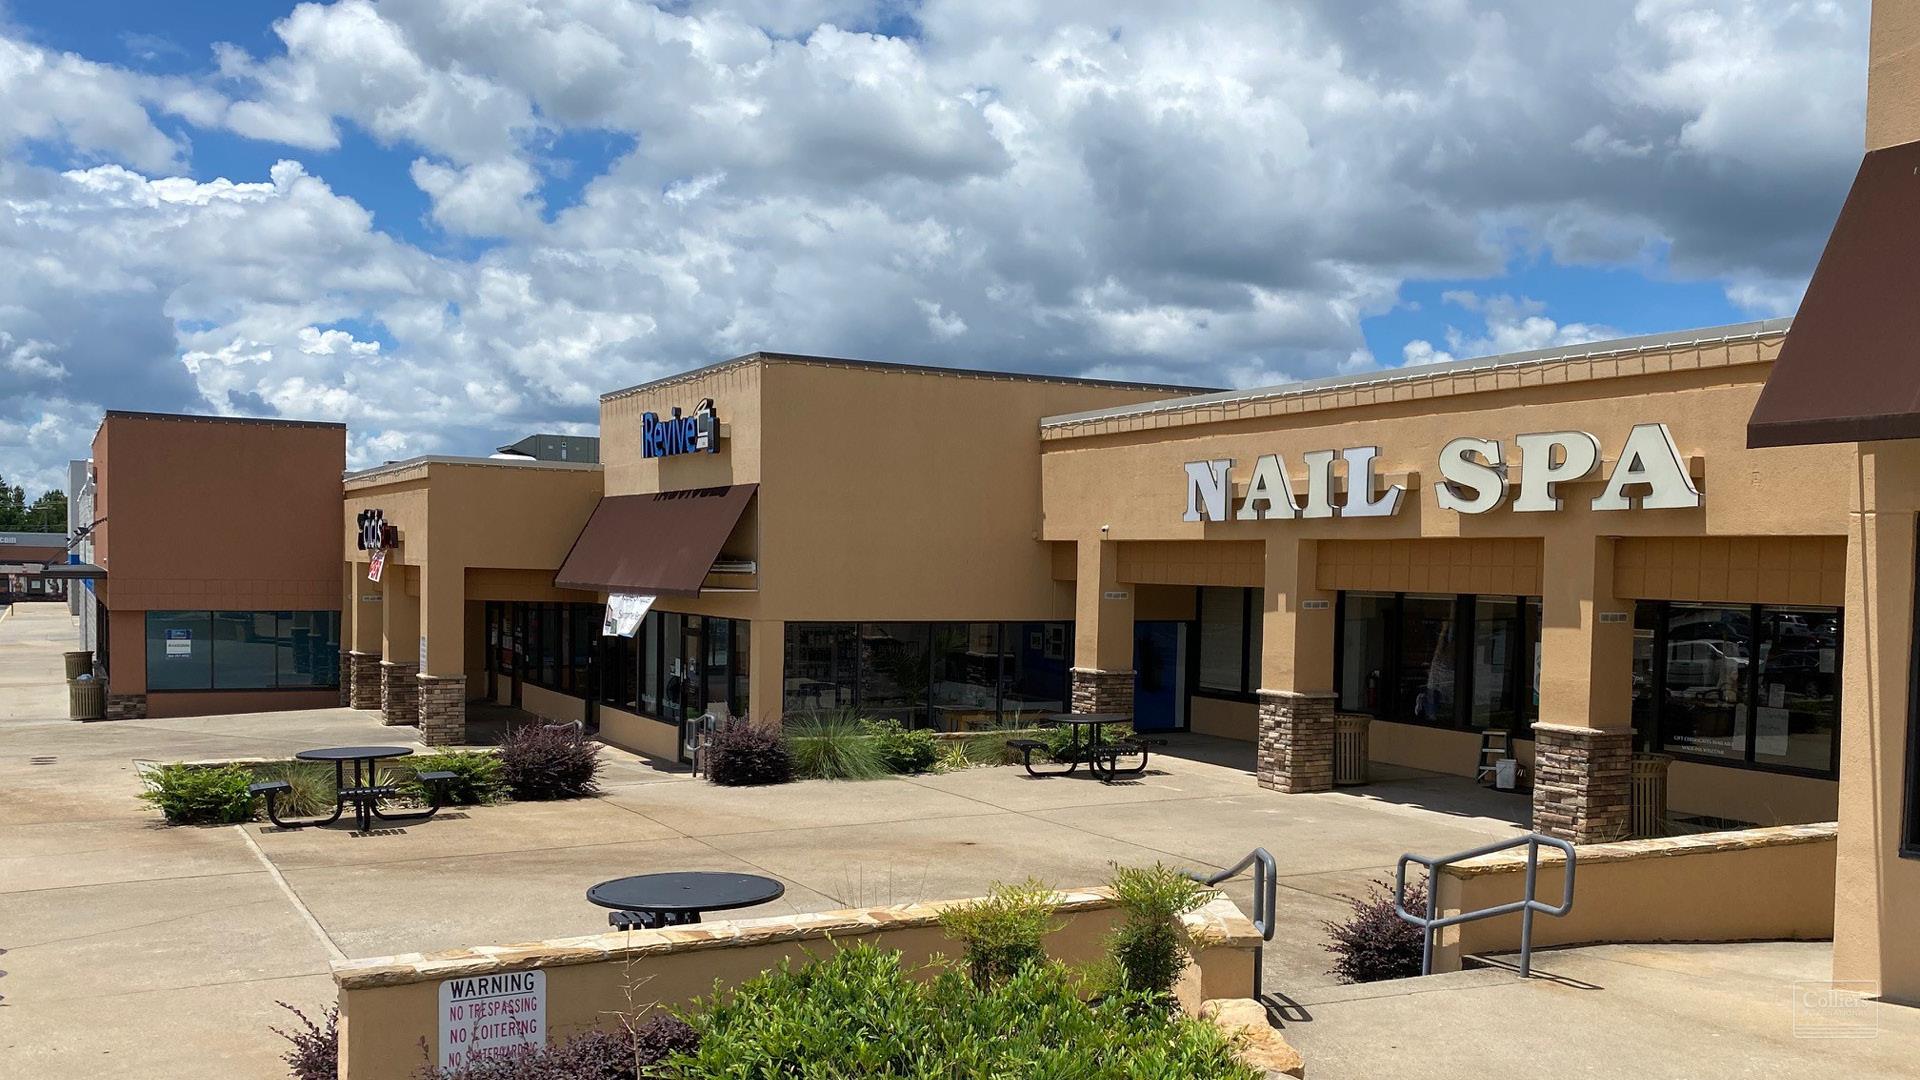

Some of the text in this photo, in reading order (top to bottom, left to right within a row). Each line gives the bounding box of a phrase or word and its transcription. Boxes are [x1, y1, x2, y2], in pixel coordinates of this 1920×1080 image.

[640, 407, 696, 458] iRevive
[1183, 423, 1703, 522] NAIL SPA
[451, 972, 535, 999] WARNING
[449, 996, 538, 1022] NO TRESPASSING
[450, 1019, 537, 1044] NO LOITERING
[448, 1052, 461, 1068] NO
